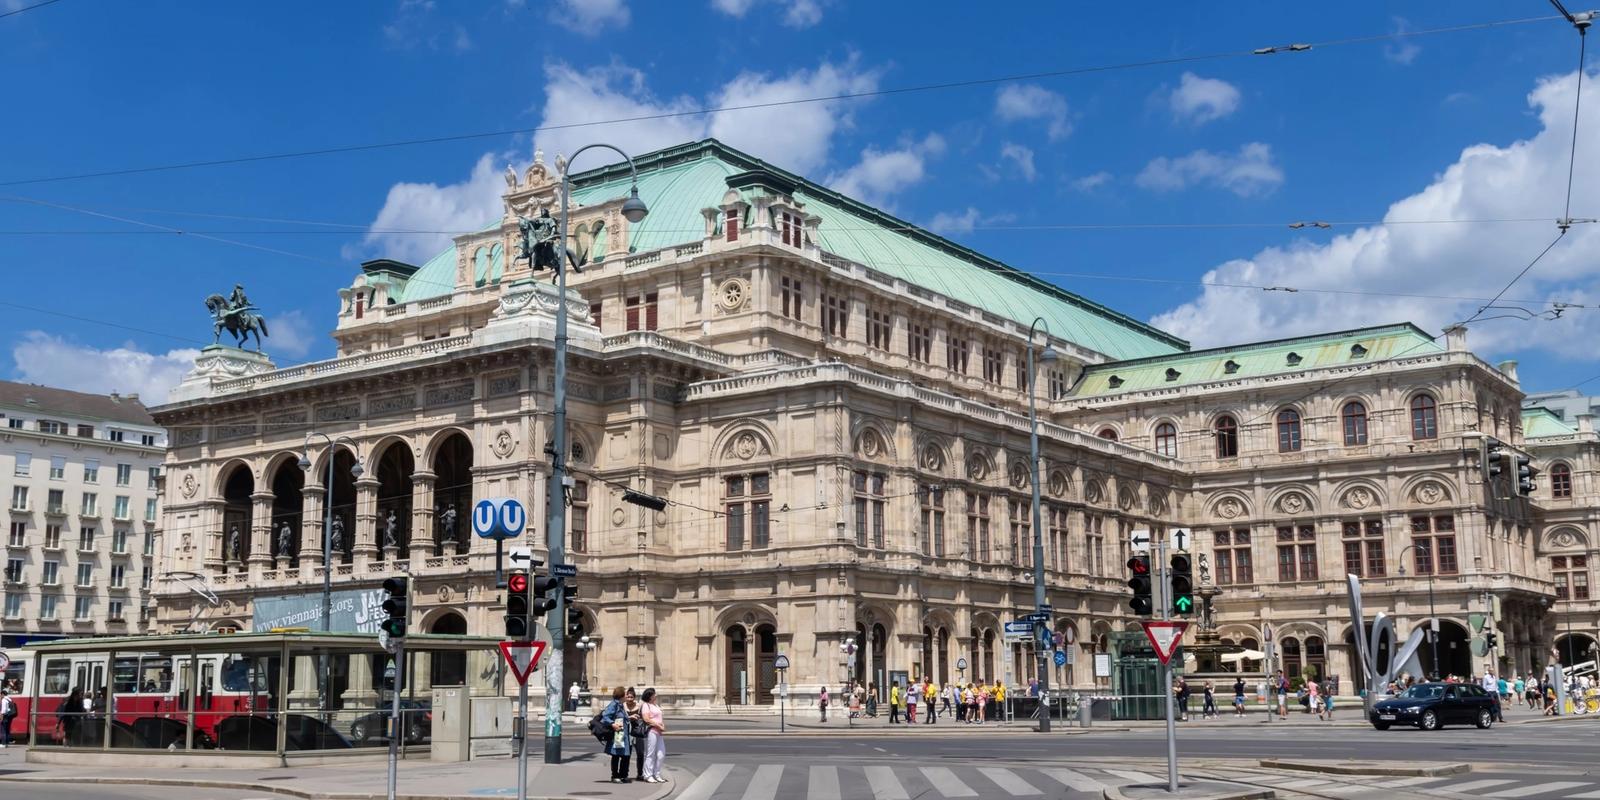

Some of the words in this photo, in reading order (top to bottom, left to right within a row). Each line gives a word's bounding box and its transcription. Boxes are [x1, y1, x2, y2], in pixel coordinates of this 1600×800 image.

[476, 507, 493, 533] U
[503, 505, 522, 532] U
[256, 598, 354, 632] www.viennajaz.org
[357, 618, 388, 633] WIE
